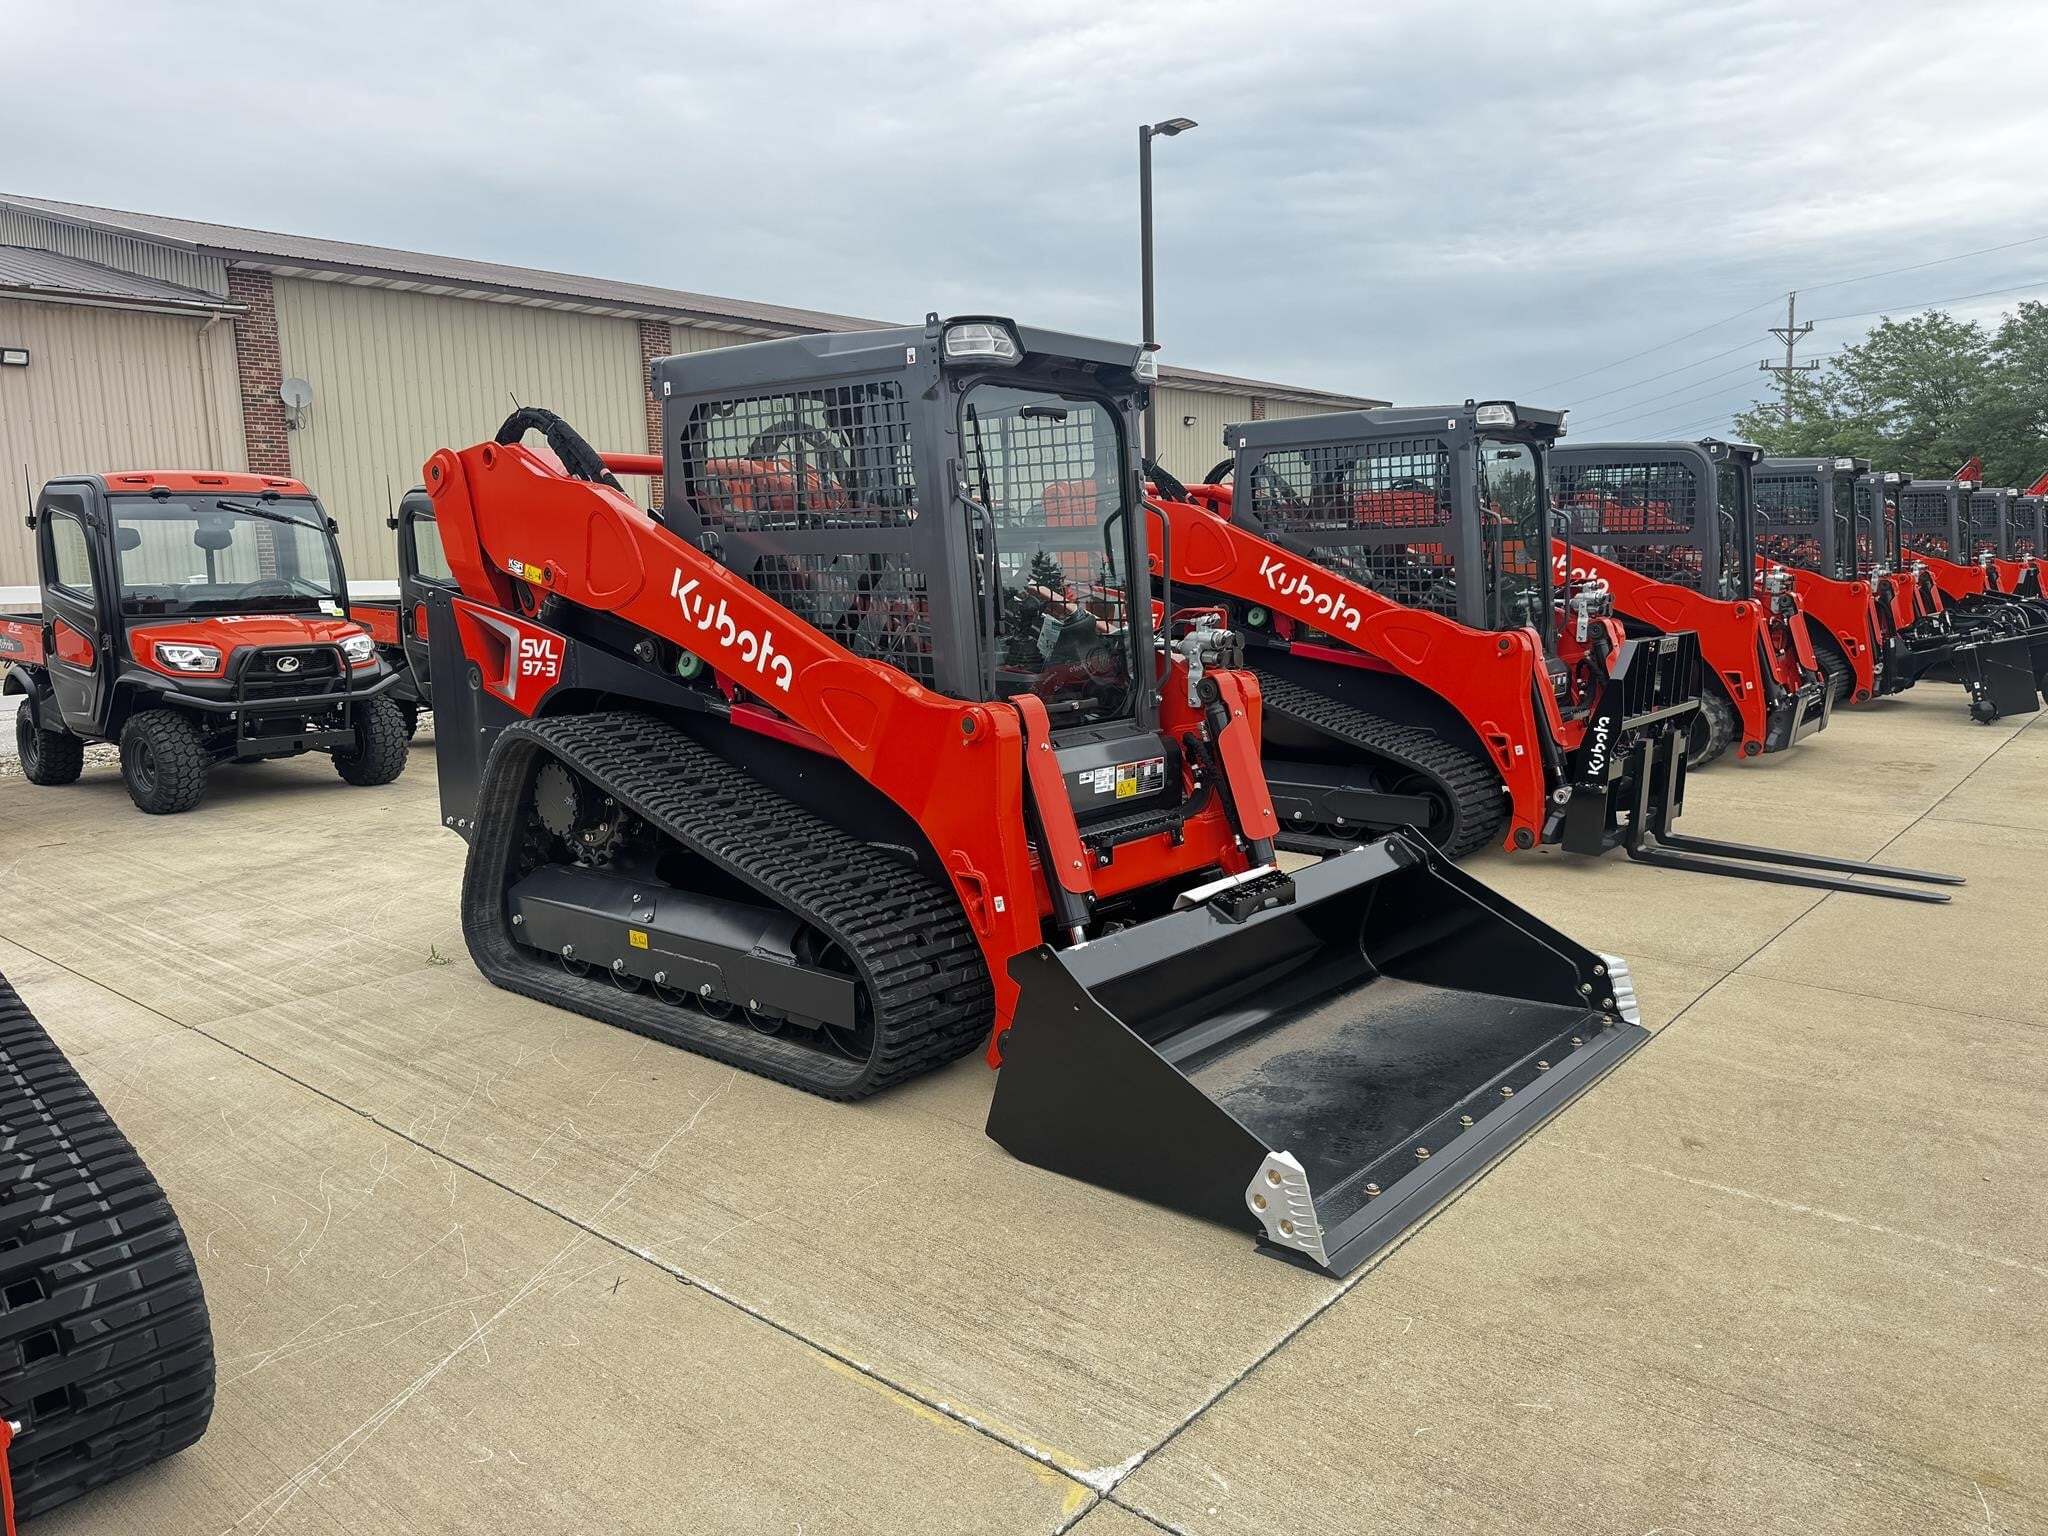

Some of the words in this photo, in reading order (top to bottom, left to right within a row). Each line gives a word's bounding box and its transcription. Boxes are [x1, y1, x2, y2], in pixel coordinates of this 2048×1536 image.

[1259, 555, 1360, 631] Kubota
[520, 638, 558, 659] SVL
[670, 567, 793, 692] Kubota
[522, 660, 556, 677] 97-3
[1587, 716, 1610, 775] Kubota
